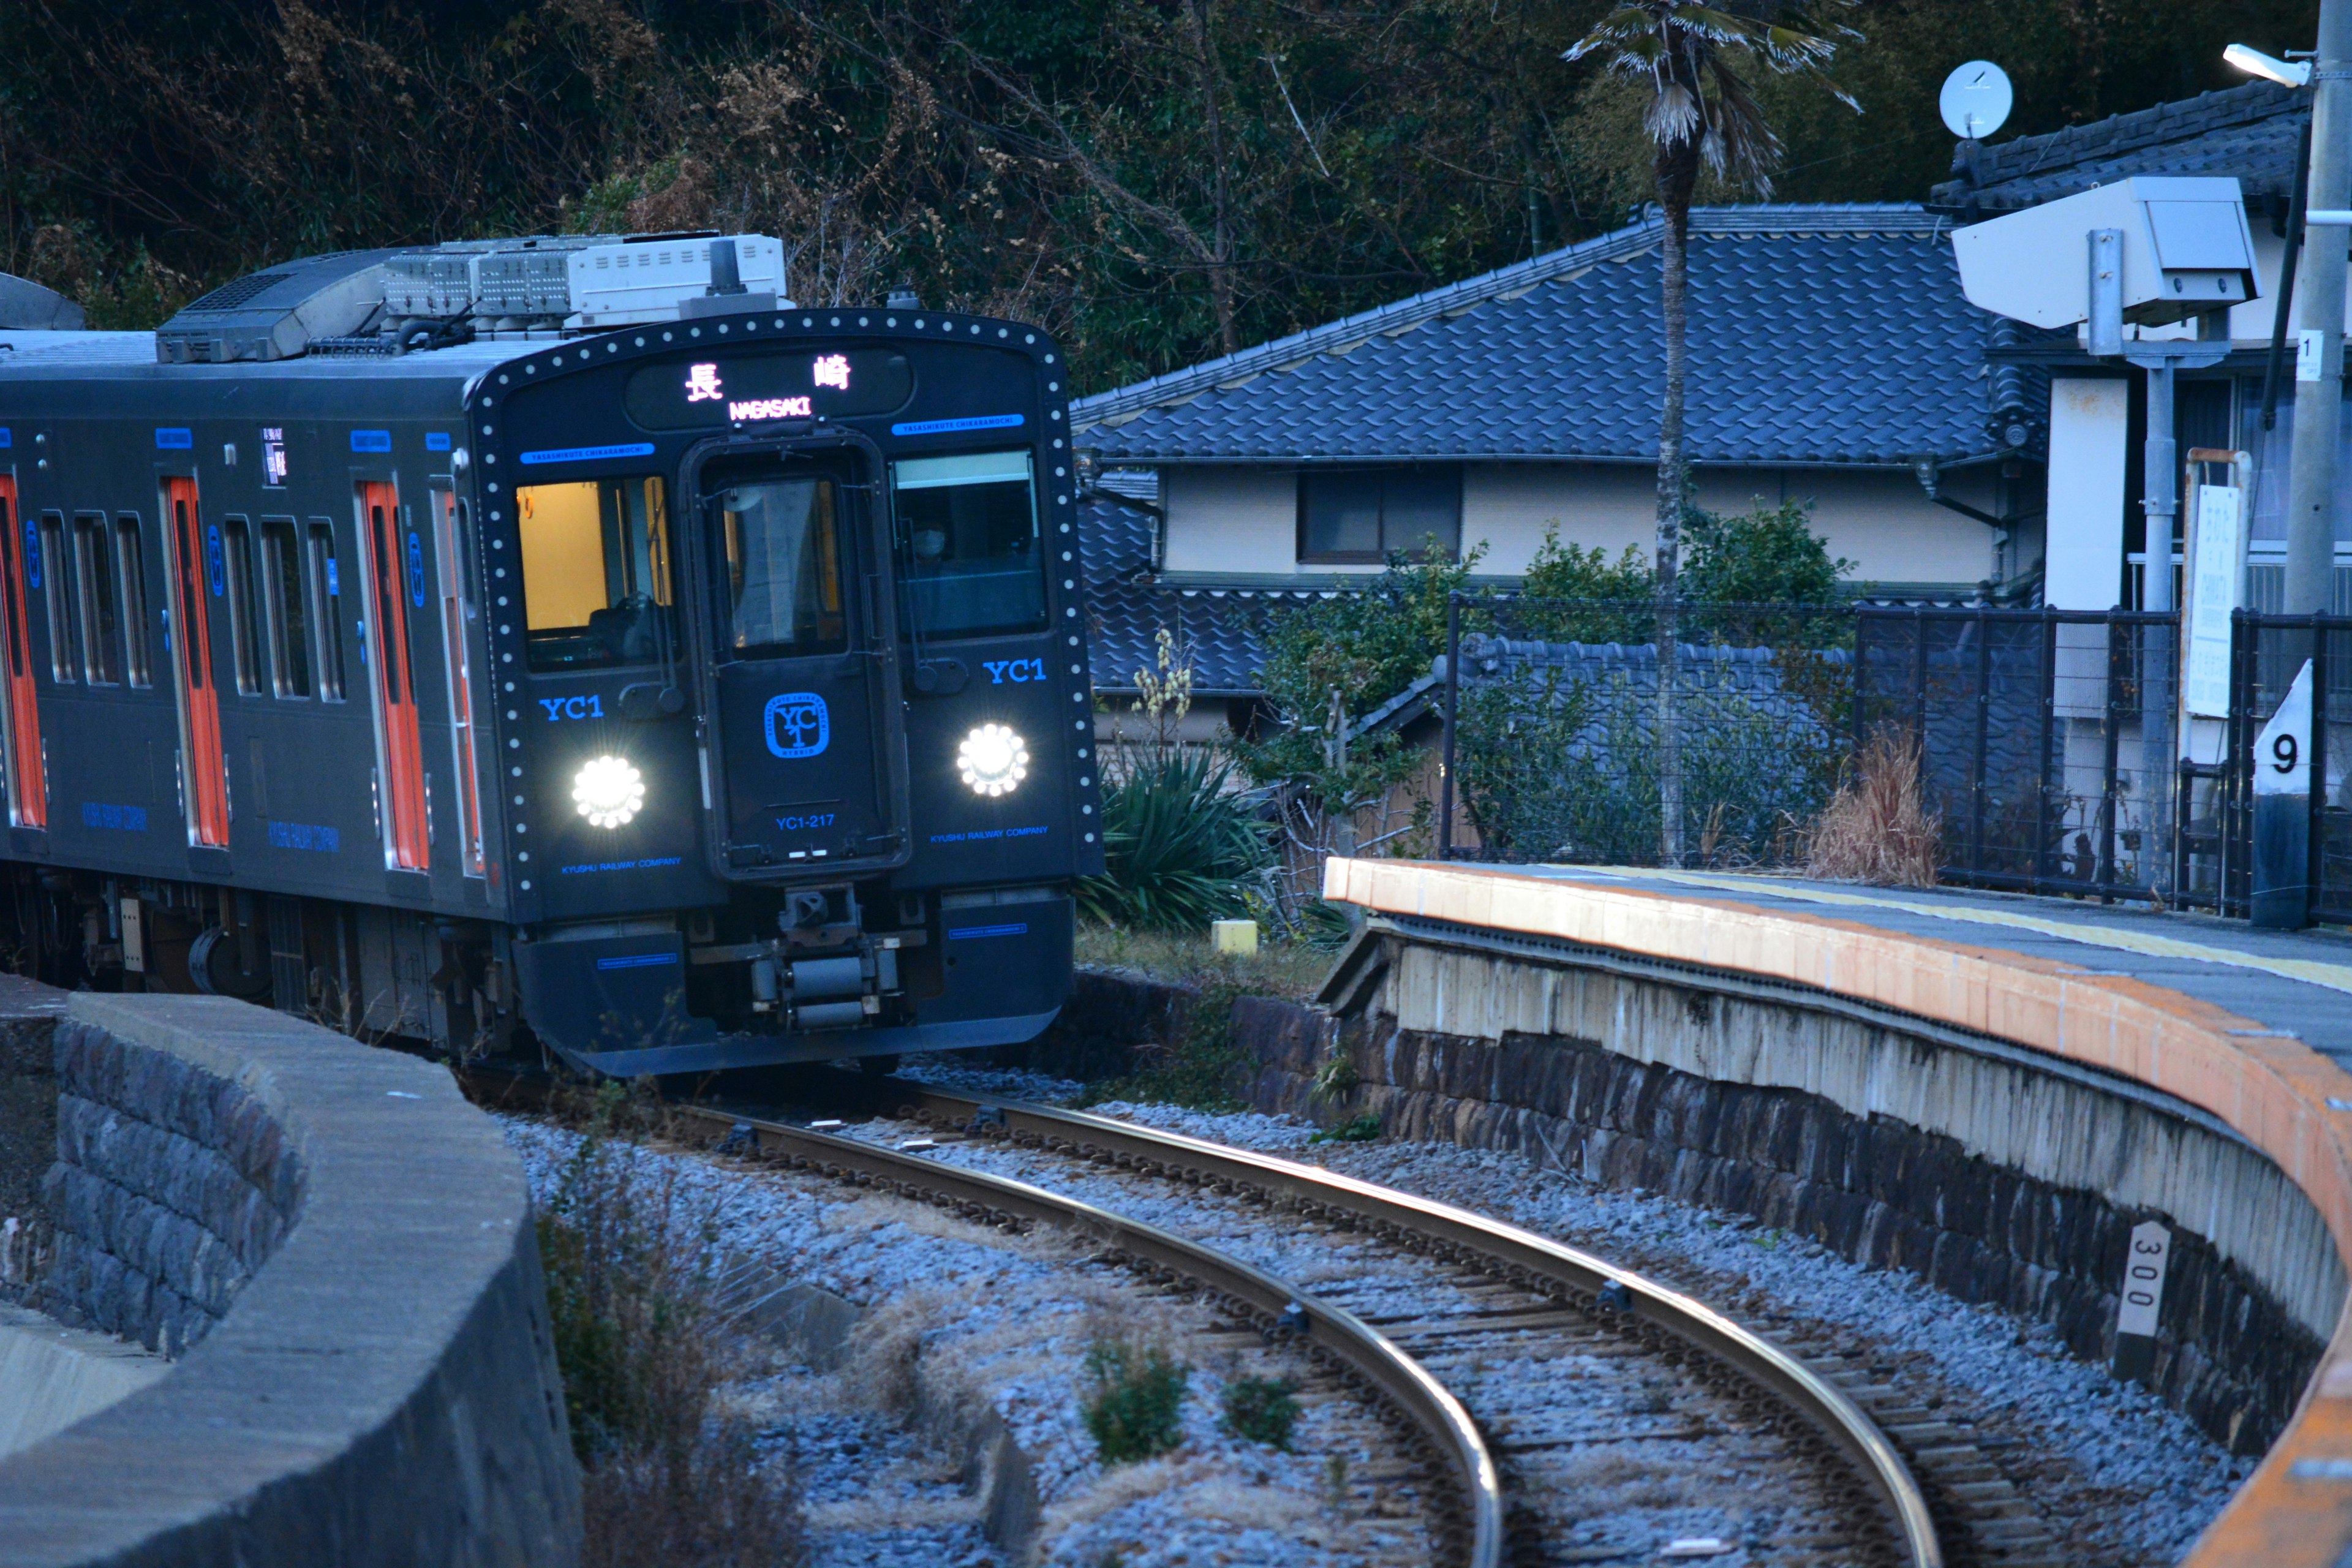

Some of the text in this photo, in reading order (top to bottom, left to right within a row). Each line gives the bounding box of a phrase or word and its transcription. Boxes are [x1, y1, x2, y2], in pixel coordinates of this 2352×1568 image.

[2304, 338, 2310, 356] 1
[729, 397, 811, 420] NAGASAKI
[903, 418, 1014, 432] YASASHIKUTE CHIKARAMOCHI
[532, 447, 643, 461] YASASHIKUTE CHIKARAMOCHI
[983, 658, 1047, 684] YC1
[539, 695, 605, 721] YC1
[2273, 734, 2297, 774] 9
[776, 814, 835, 830] YC1-217
[930, 826, 1048, 843] KYUSHU RAILWAY COMPANY
[562, 857, 681, 874] KYUSHU RAILWAY COMPANY
[2127, 1240, 2162, 1307] 300
